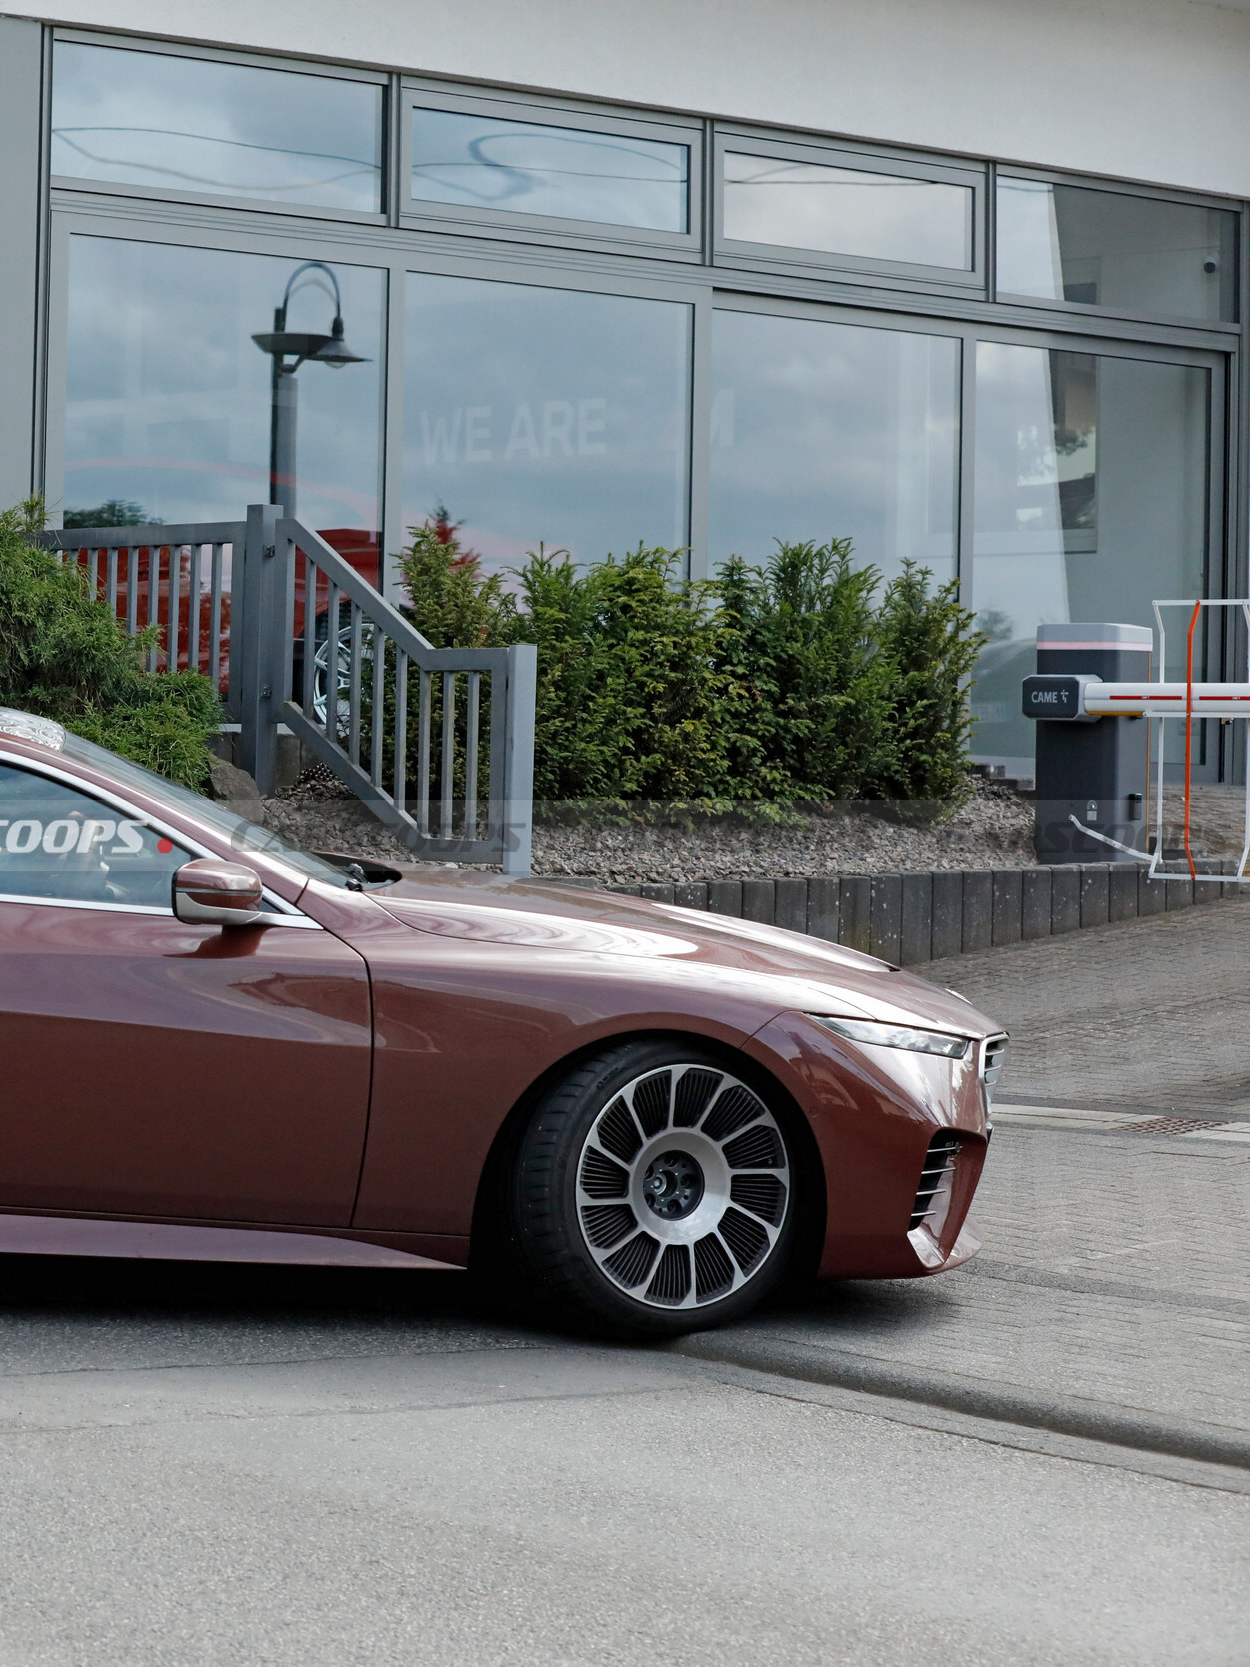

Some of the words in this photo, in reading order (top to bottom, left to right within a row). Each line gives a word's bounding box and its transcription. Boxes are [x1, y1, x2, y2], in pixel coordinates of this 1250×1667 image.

[419, 405, 493, 466] WE
[503, 397, 607, 461] ARE
[1031, 691, 1058, 703] CAME
